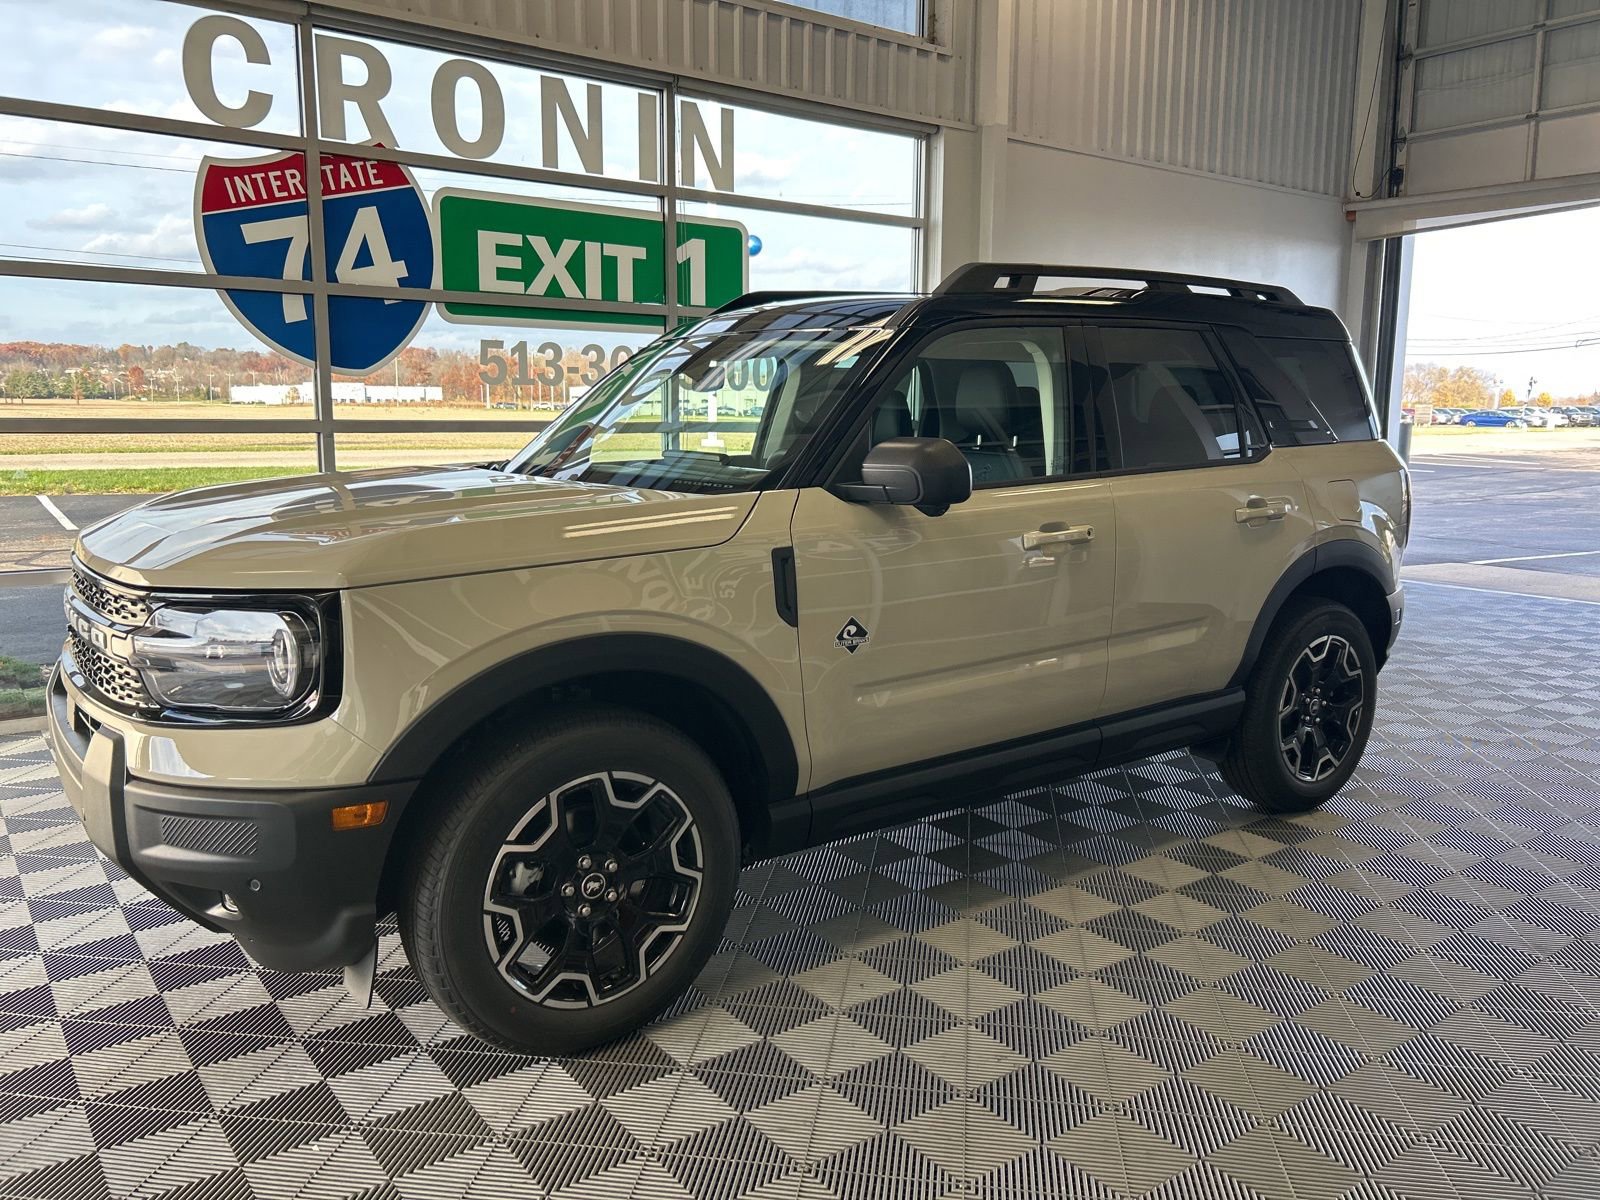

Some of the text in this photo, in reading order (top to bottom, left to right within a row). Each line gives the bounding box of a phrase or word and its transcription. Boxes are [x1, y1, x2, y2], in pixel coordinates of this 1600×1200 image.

[182, 14, 734, 192] CRONIN
[223, 160, 384, 204] INTERTATE
[240, 206, 409, 323] 74
[477, 229, 707, 307] EXIT 1
